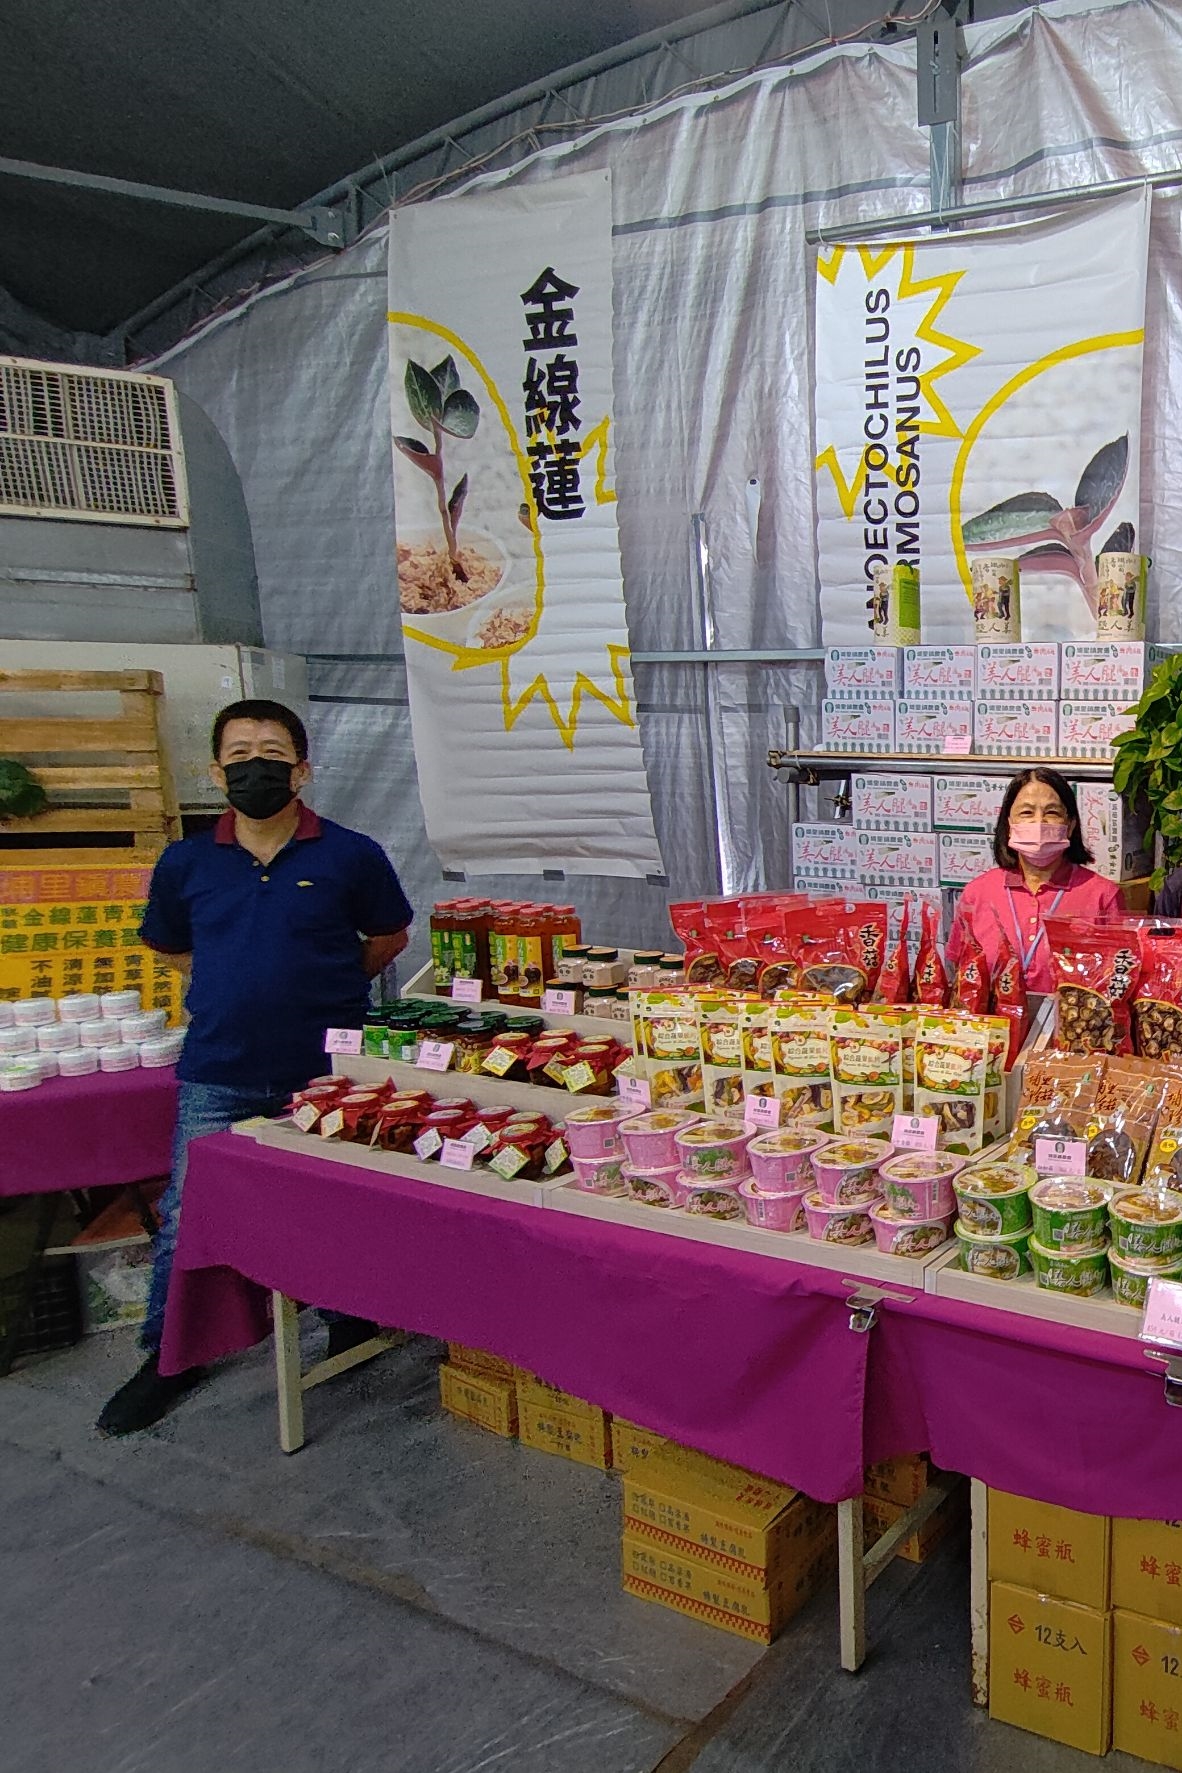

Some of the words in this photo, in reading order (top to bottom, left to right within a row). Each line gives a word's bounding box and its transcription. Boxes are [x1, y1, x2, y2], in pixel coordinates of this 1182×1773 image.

[520, 266, 586, 520] 金線蓮
[864, 288, 890, 631] OECTOCHILUS
[859, 924, 881, 968] 香菇
[1109, 950, 1132, 998] 香菇
[1012, 1528, 1076, 1564] 蜂蜜瓶
[1035, 1624, 1088, 1656] 12支入
[1012, 1668, 1074, 1708] 蜂蜜瓶
